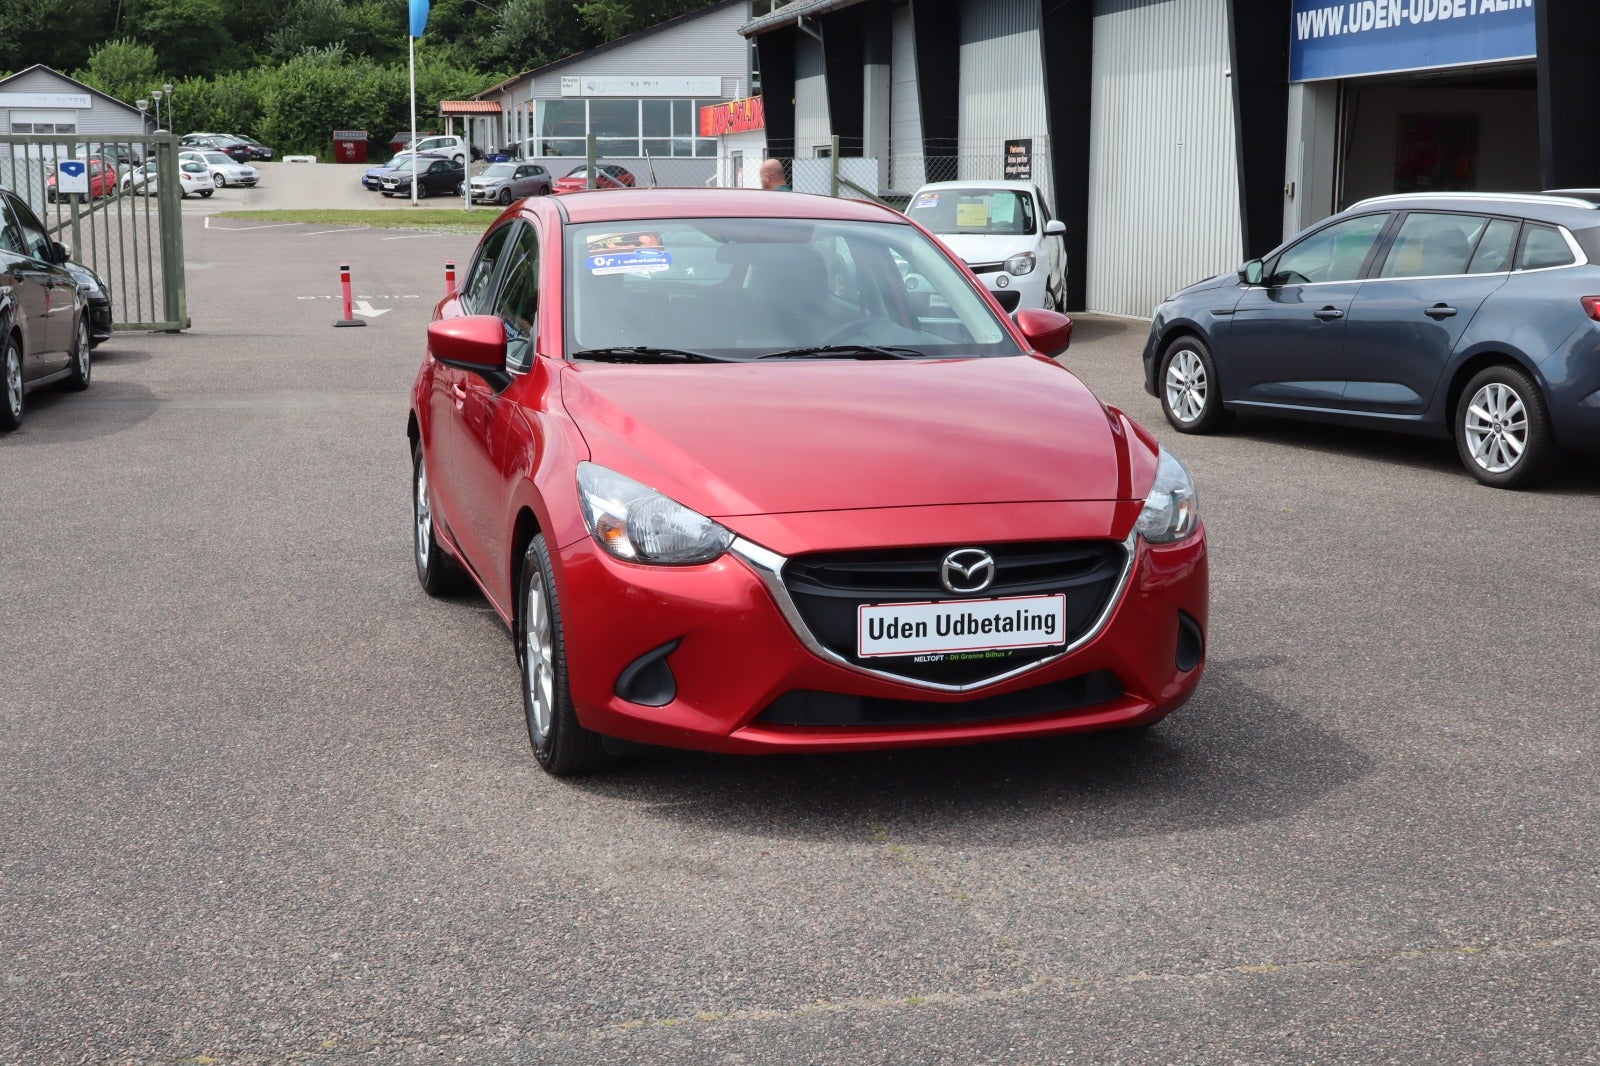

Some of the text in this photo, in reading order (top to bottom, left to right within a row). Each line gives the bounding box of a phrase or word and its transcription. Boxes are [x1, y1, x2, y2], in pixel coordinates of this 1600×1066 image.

[1297, 0, 1532, 40] WWW.UDEN-UDBE
[868, 609, 1056, 640] Uden Udbetaling
[913, 654, 945, 663] NELTOFT
[949, 653, 960, 661] Dit
